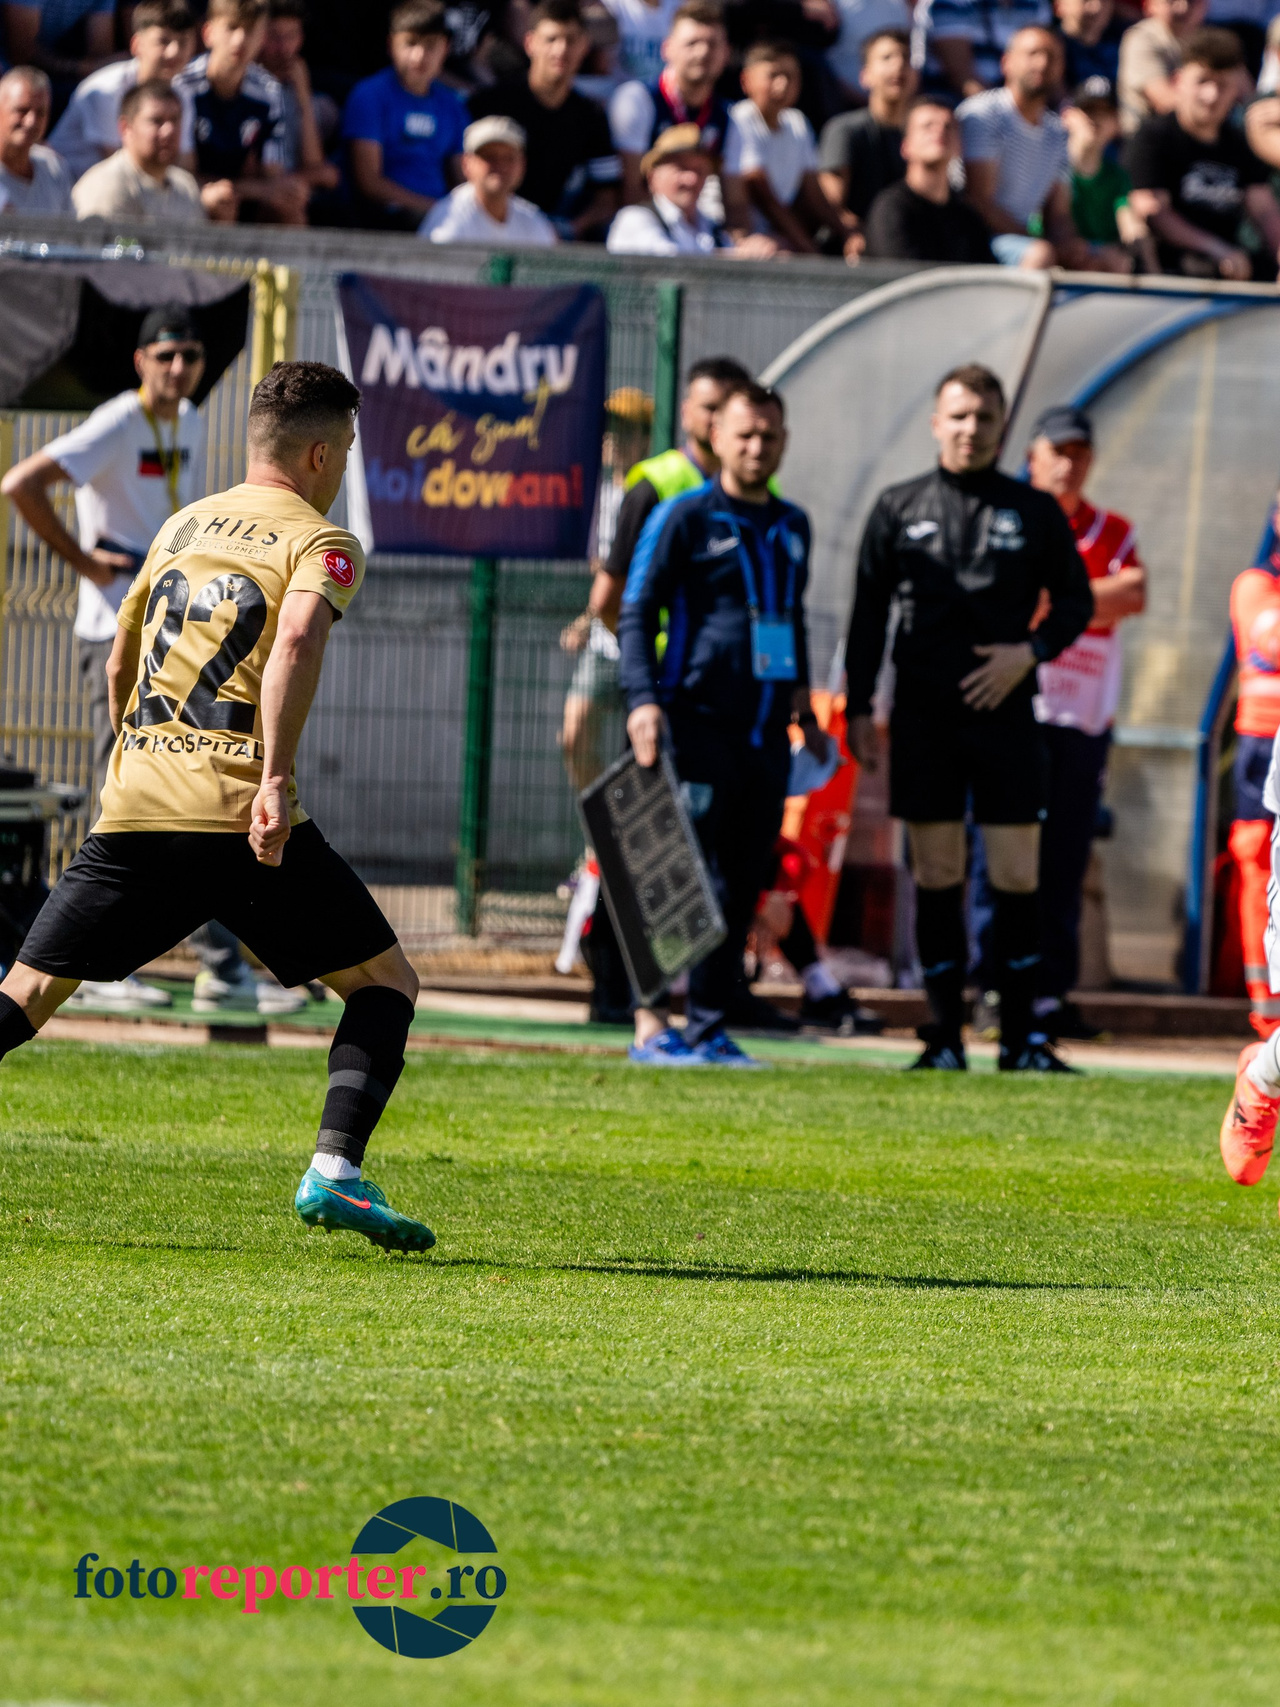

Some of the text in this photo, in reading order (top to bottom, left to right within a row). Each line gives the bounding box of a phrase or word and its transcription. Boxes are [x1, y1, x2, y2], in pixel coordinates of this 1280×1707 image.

[361, 324, 580, 396] Mândru
[203, 516, 284, 546] HILS
[122, 568, 268, 734] 22
[152, 733, 264, 761] HOSPITAL
